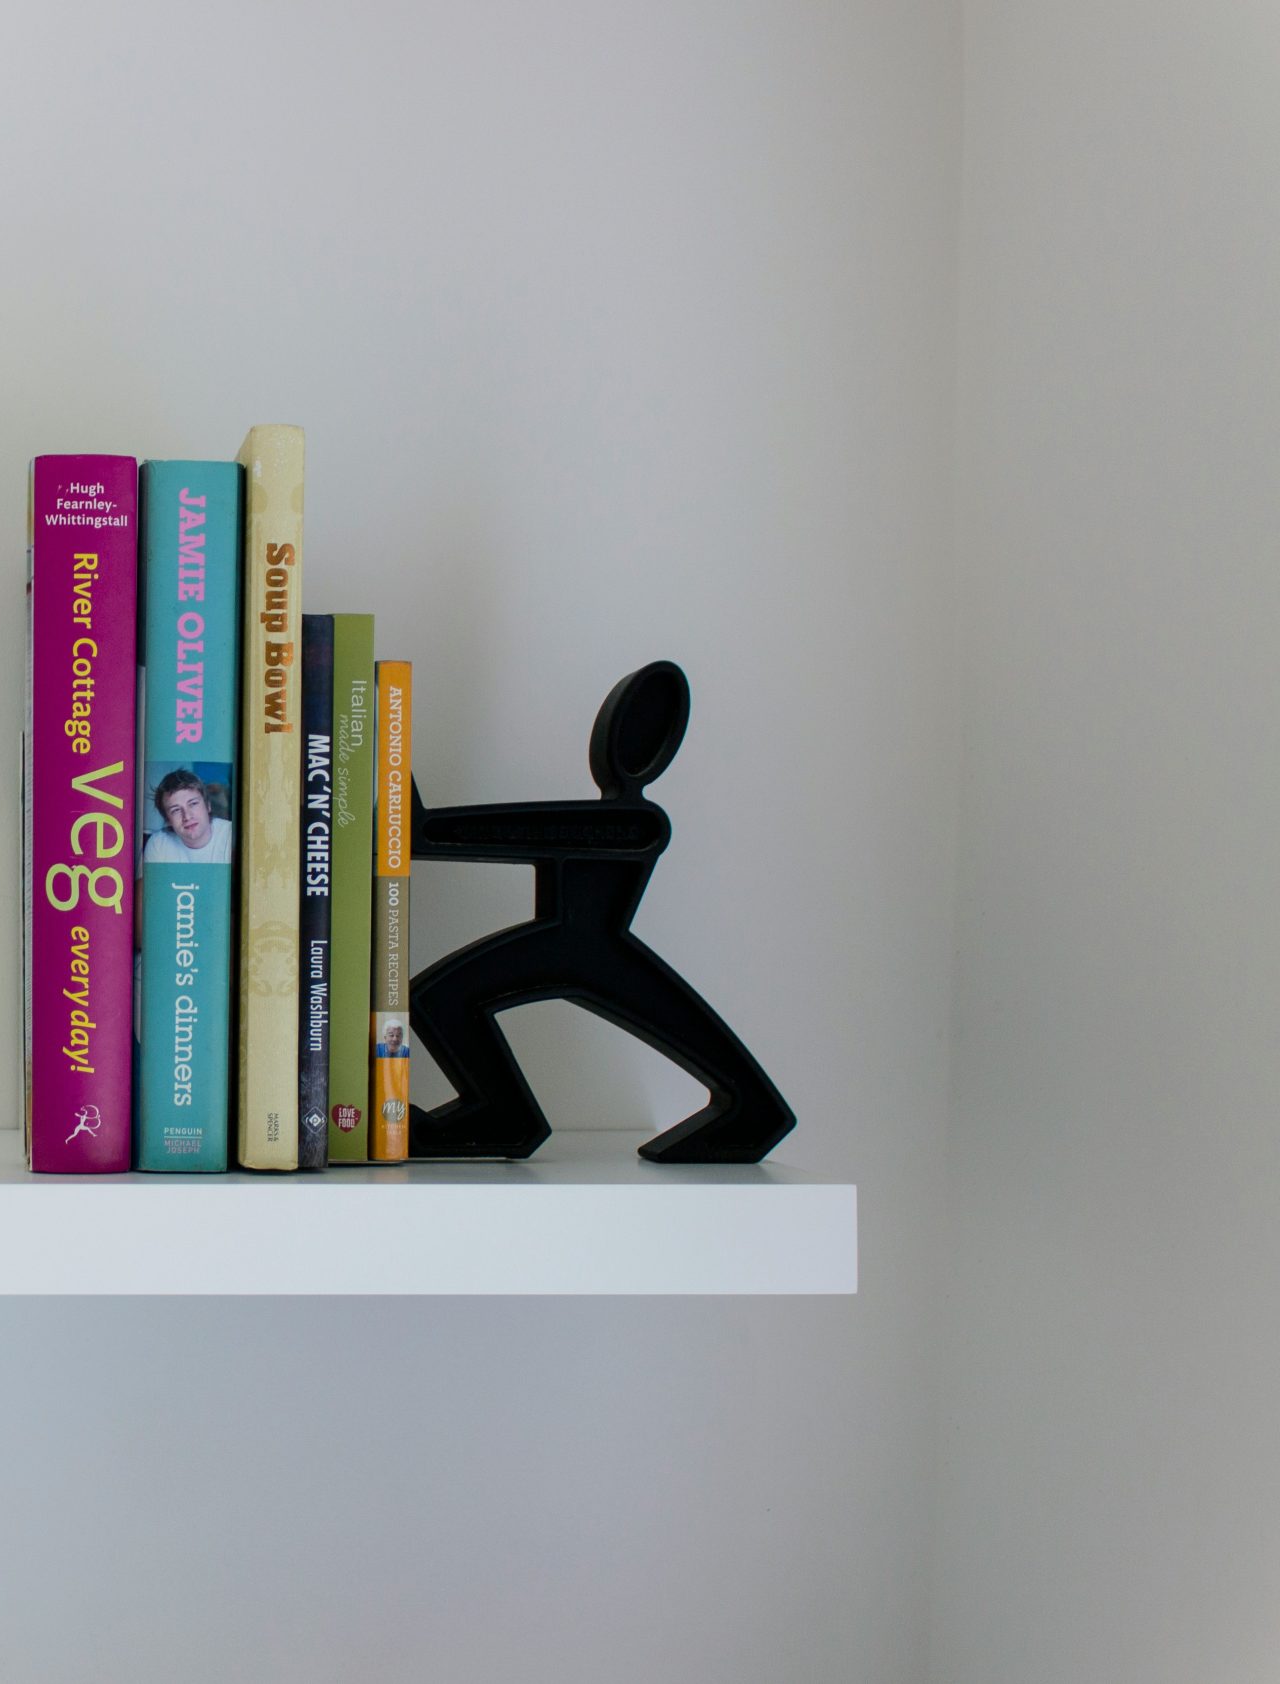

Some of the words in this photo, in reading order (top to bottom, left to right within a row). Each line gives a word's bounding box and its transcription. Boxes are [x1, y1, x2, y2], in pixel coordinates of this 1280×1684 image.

[56, 498, 118, 513] Fearnley-
[70, 482, 105, 497] Hugh
[45, 514, 128, 529] Whittingstall
[178, 488, 206, 601] JAMIE
[73, 553, 99, 629] River
[260, 543, 295, 632] Soup
[64, 638, 98, 754] Cottage
[175, 611, 205, 744] OLIVER
[264, 641, 294, 734] Bowl
[338, 713, 355, 764] made
[351, 680, 367, 746] Italian
[388, 686, 402, 767] ANTONIO
[308, 734, 330, 782] MAC
[332, 767, 356, 828] simple
[387, 770, 402, 869] CARLUCCIO
[306, 821, 330, 897] CHEESE
[388, 882, 399, 906] 100
[172, 883, 200, 986] jamie's
[310, 940, 327, 978] Laura
[388, 910, 400, 950] PASTA
[388, 953, 399, 1006] RECIPES
[310, 983, 328, 1051] Washburn
[173, 995, 198, 1106] dinners
[164, 1127, 203, 1135] PENGUIN
[338, 1107, 356, 1117] LOVE
[338, 1118, 356, 1128] FOOD
[382, 1101, 406, 1121] my
